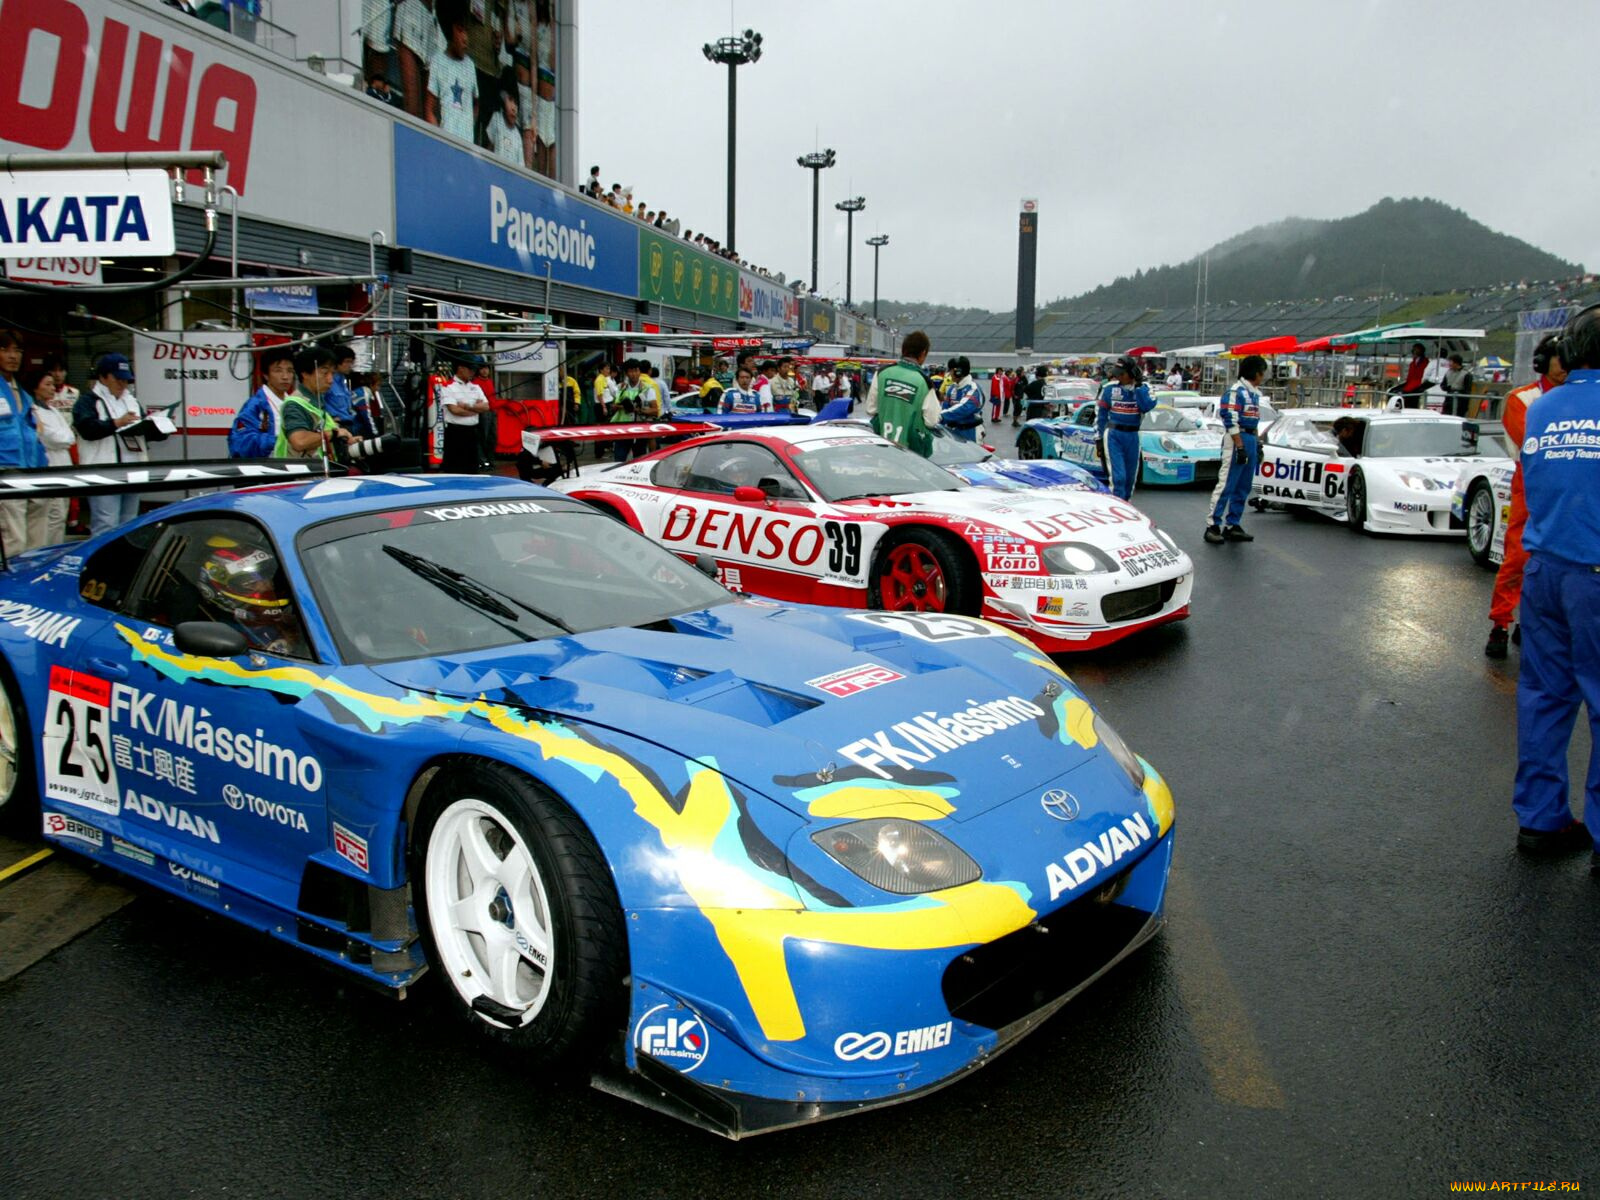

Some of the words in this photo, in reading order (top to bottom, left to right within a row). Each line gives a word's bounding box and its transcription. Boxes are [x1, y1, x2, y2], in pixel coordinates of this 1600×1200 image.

[490, 184, 596, 271] Panasonic
[153, 344, 229, 360] DENSO
[203, 408, 236, 416] TOYOTA
[1544, 419, 1600, 434] ADVA
[1544, 448, 1575, 460] Racing
[1263, 485, 1306, 500] PIAA
[424, 502, 551, 521] YOKOHAMA
[1394, 501, 1418, 512] Mobil
[1023, 505, 1142, 540] DENSO
[662, 504, 825, 567] DENSO
[825, 520, 861, 577] 39
[1117, 542, 1162, 560] ADVAN
[990, 579, 1009, 588] L&F
[864, 611, 992, 640] 25
[808, 674, 835, 687] Racing
[834, 663, 877, 681] Development
[824, 670, 897, 693] TRD
[56, 698, 110, 785] 25
[49, 782, 118, 807] www.jgtc.net
[124, 789, 221, 844] ADVAN
[245, 793, 310, 833] TOYOTA
[67, 822, 103, 842] BRIDE
[1044, 811, 1152, 901] ADVAN
[893, 1021, 953, 1057] ENKEI
